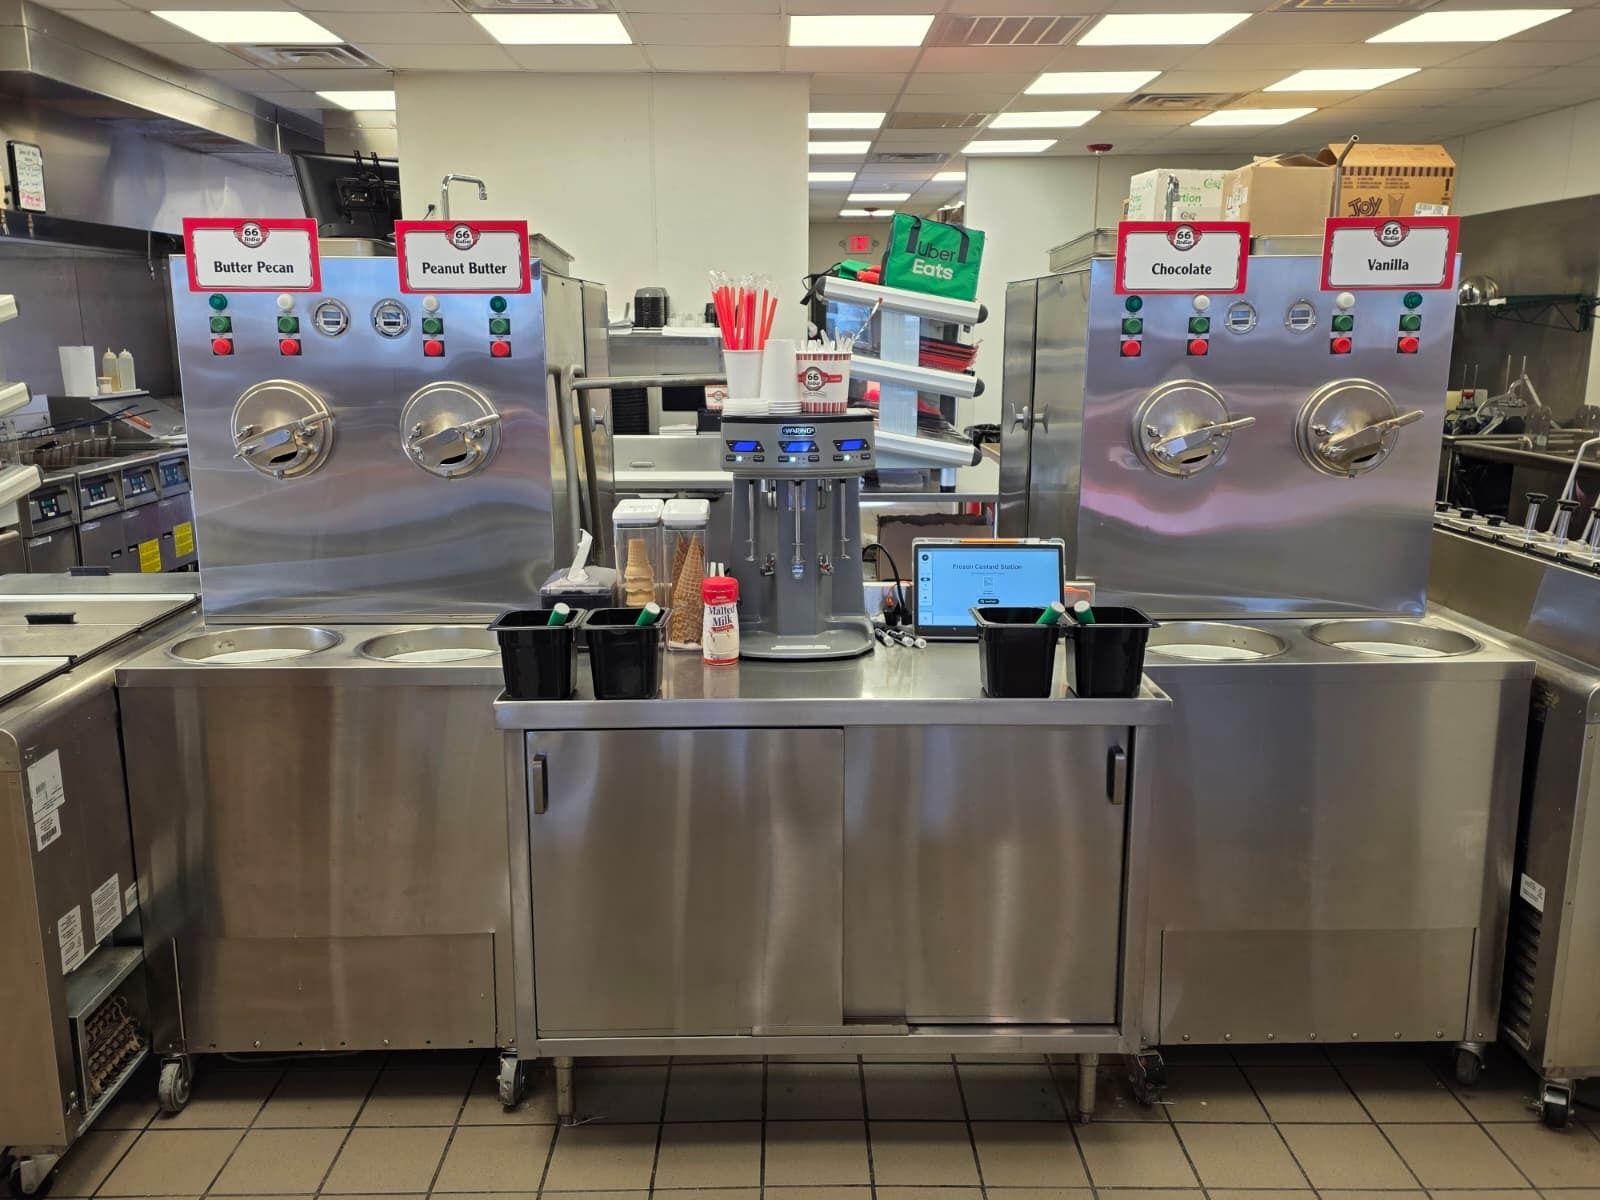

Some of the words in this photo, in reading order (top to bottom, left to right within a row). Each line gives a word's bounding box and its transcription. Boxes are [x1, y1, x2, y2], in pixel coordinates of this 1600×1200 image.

[244, 228, 259, 236] 66
[455, 230, 470, 239] 66
[1177, 231, 1191, 239] 66
[1384, 227, 1399, 235] 66
[917, 241, 956, 263] Uber
[213, 260, 253, 273] Butter
[256, 260, 294, 273] Pecan
[422, 262, 465, 274] Peanut
[468, 262, 507, 274] Butter
[912, 258, 954, 280] Eats
[1151, 262, 1212, 275] Chocolate
[1367, 258, 1409, 271] Vanilla
[807, 373, 819, 381] 66
[708, 603, 735, 615] Malted
[712, 614, 733, 627] Milk
